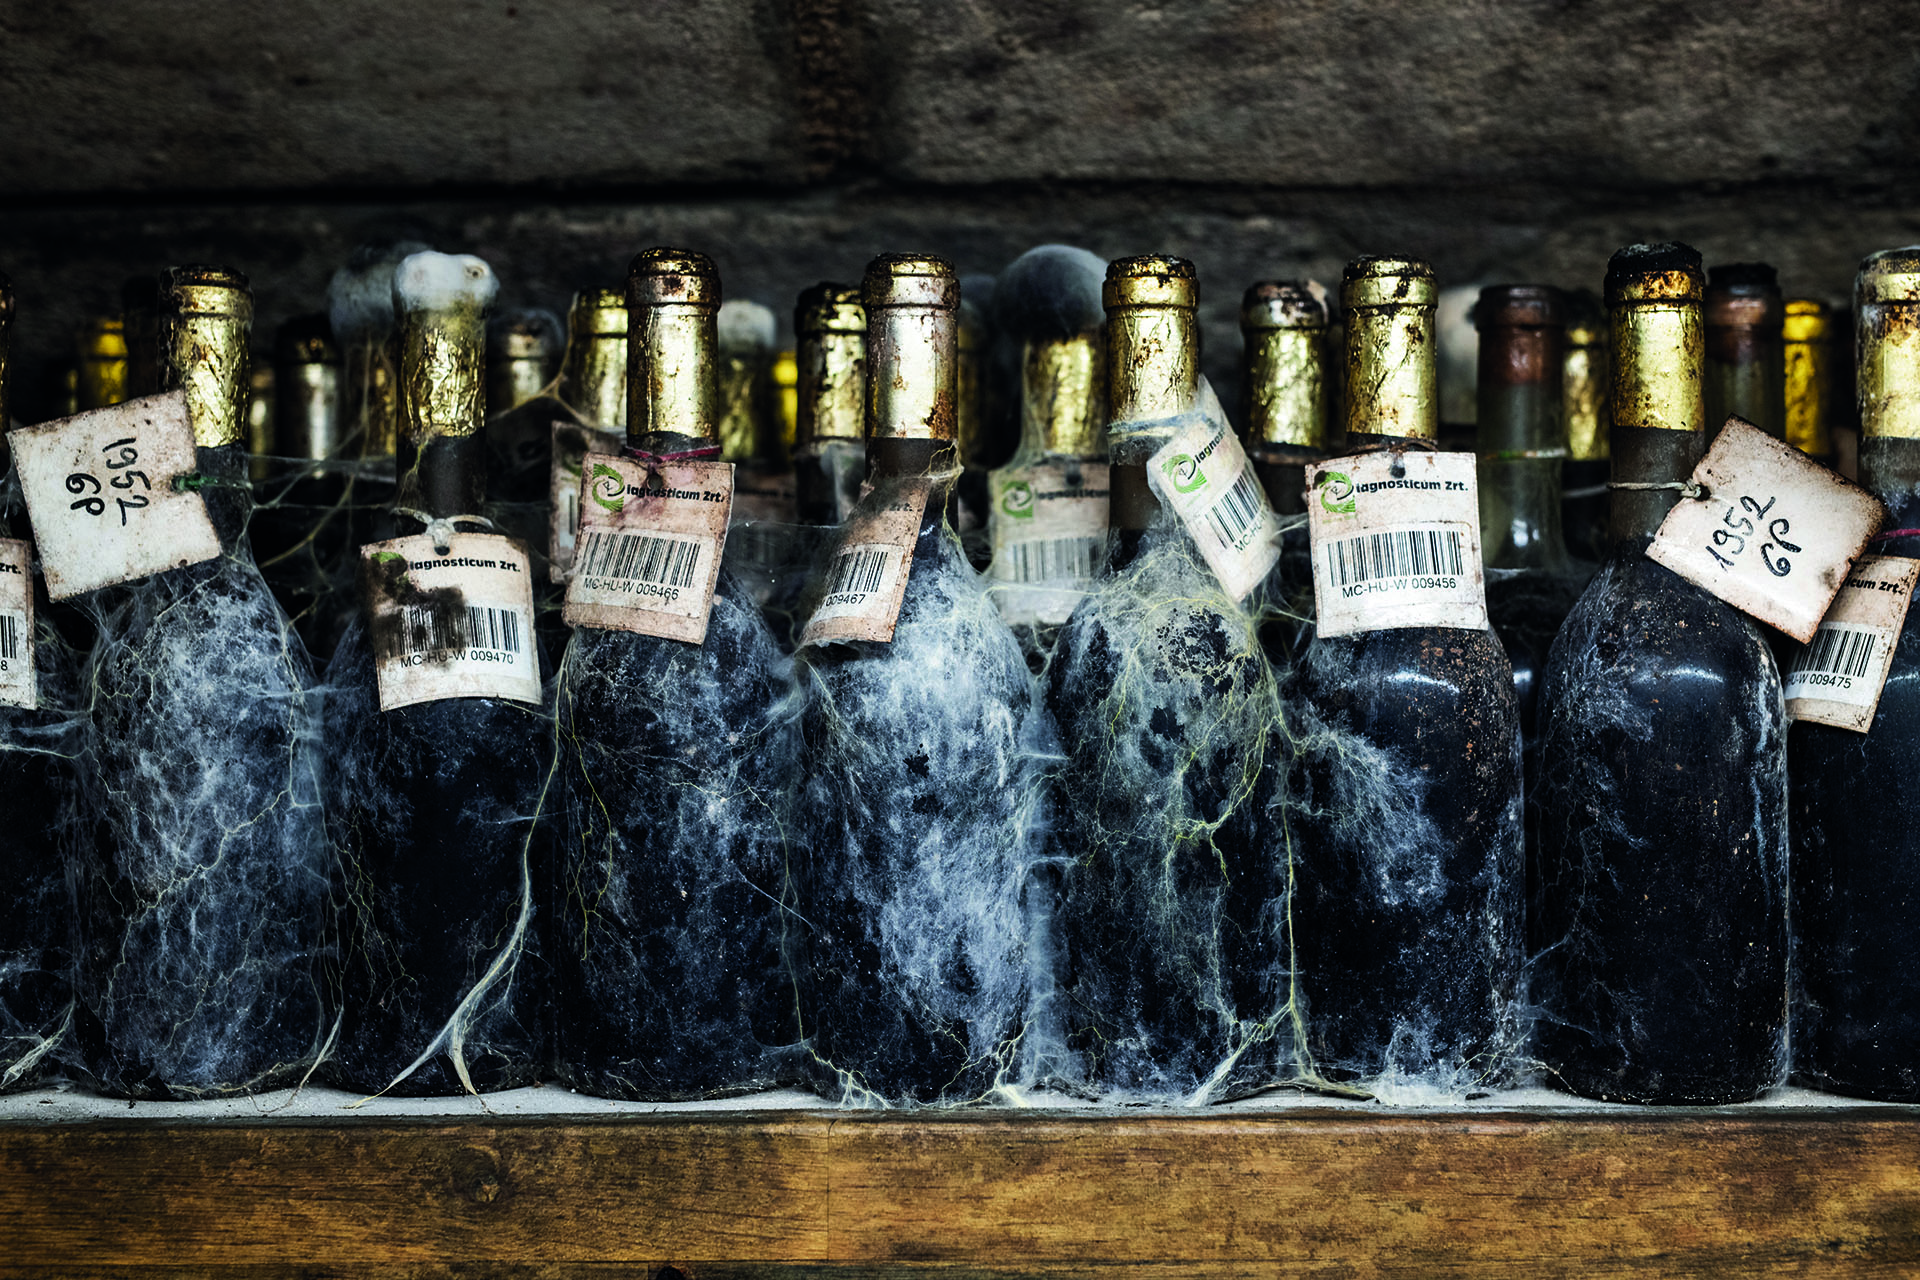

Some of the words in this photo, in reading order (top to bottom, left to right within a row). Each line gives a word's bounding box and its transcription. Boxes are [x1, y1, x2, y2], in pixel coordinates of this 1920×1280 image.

[102, 437, 151, 526] 1952
[1705, 495, 1776, 572] 1952
[583, 577, 634, 593] MC-HU-W
[636, 582, 680, 601] 009466
[1342, 578, 1408, 599] MC-HU-W
[1411, 577, 1457, 590] 009456
[826, 593, 866, 607] 009467
[400, 649, 466, 669] MC-HU-W
[471, 649, 514, 665] 009470
[1810, 673, 1852, 689] 009475
